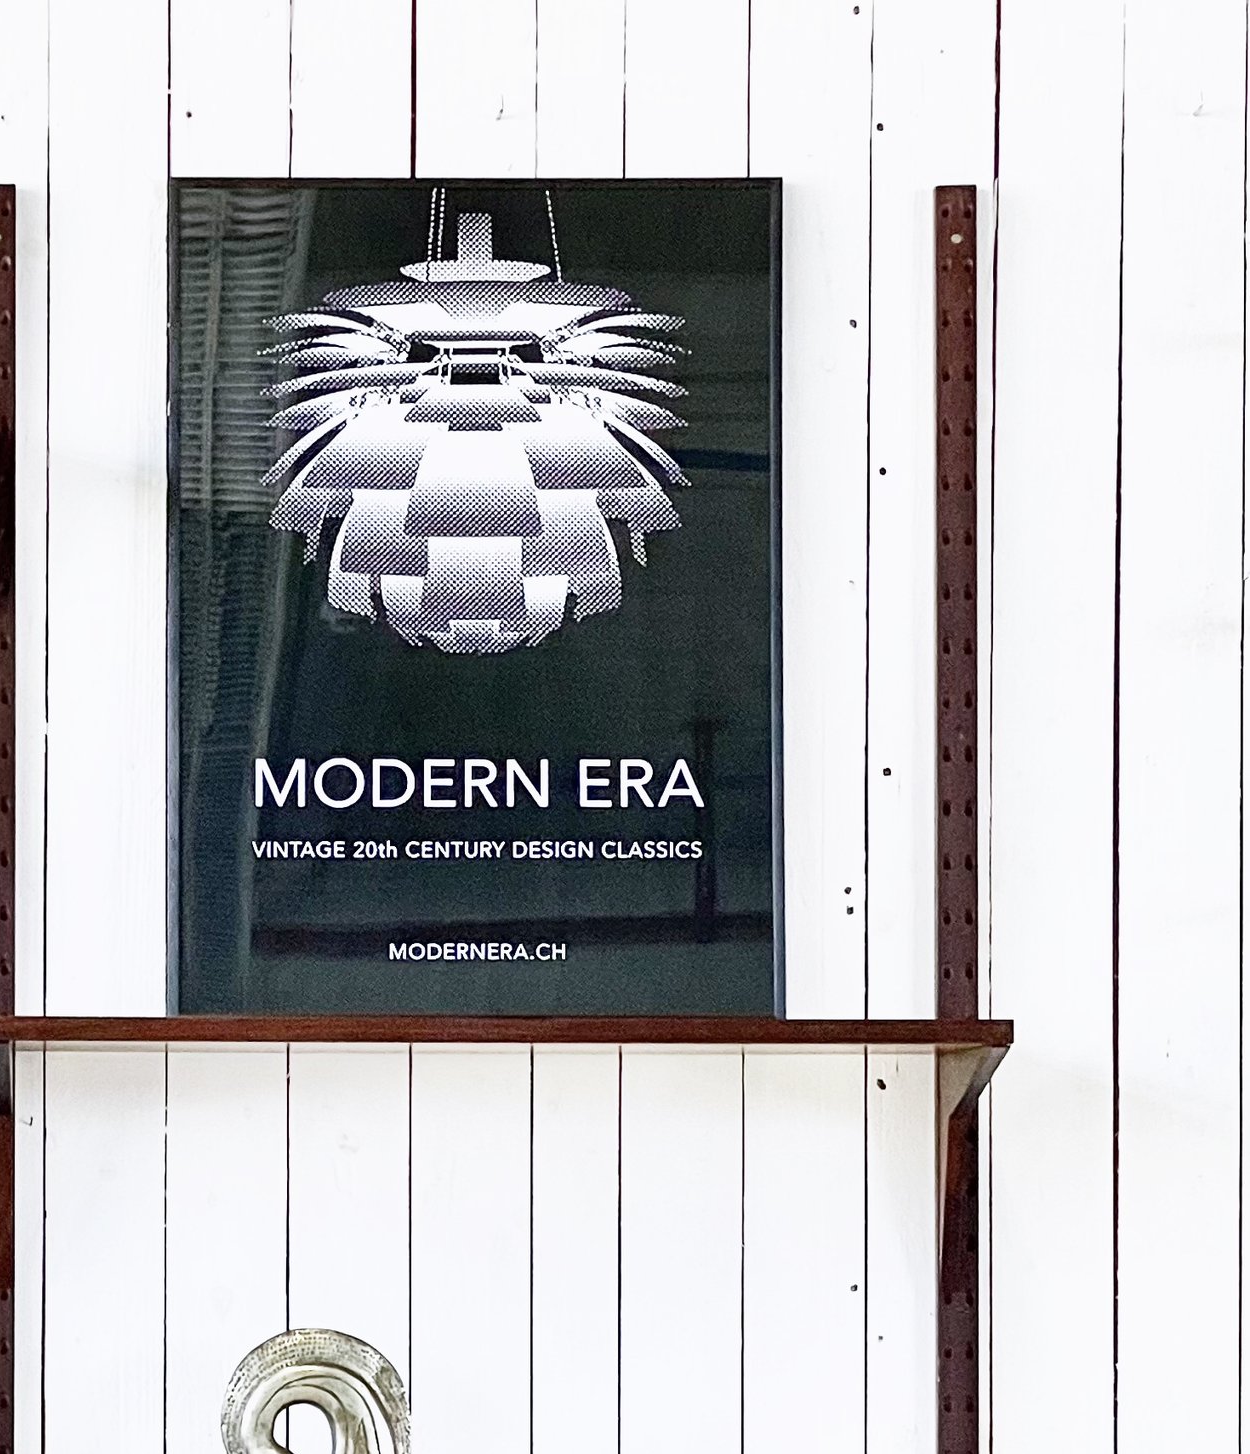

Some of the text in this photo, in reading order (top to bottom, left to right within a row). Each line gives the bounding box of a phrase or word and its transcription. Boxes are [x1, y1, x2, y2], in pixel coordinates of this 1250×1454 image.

[254, 757, 705, 809] MODERN ERA
[251, 839, 703, 859] VINTAGE 20th CENTURY DESIGN CLASSICS
[388, 942, 566, 961] MODERNERA.CH
